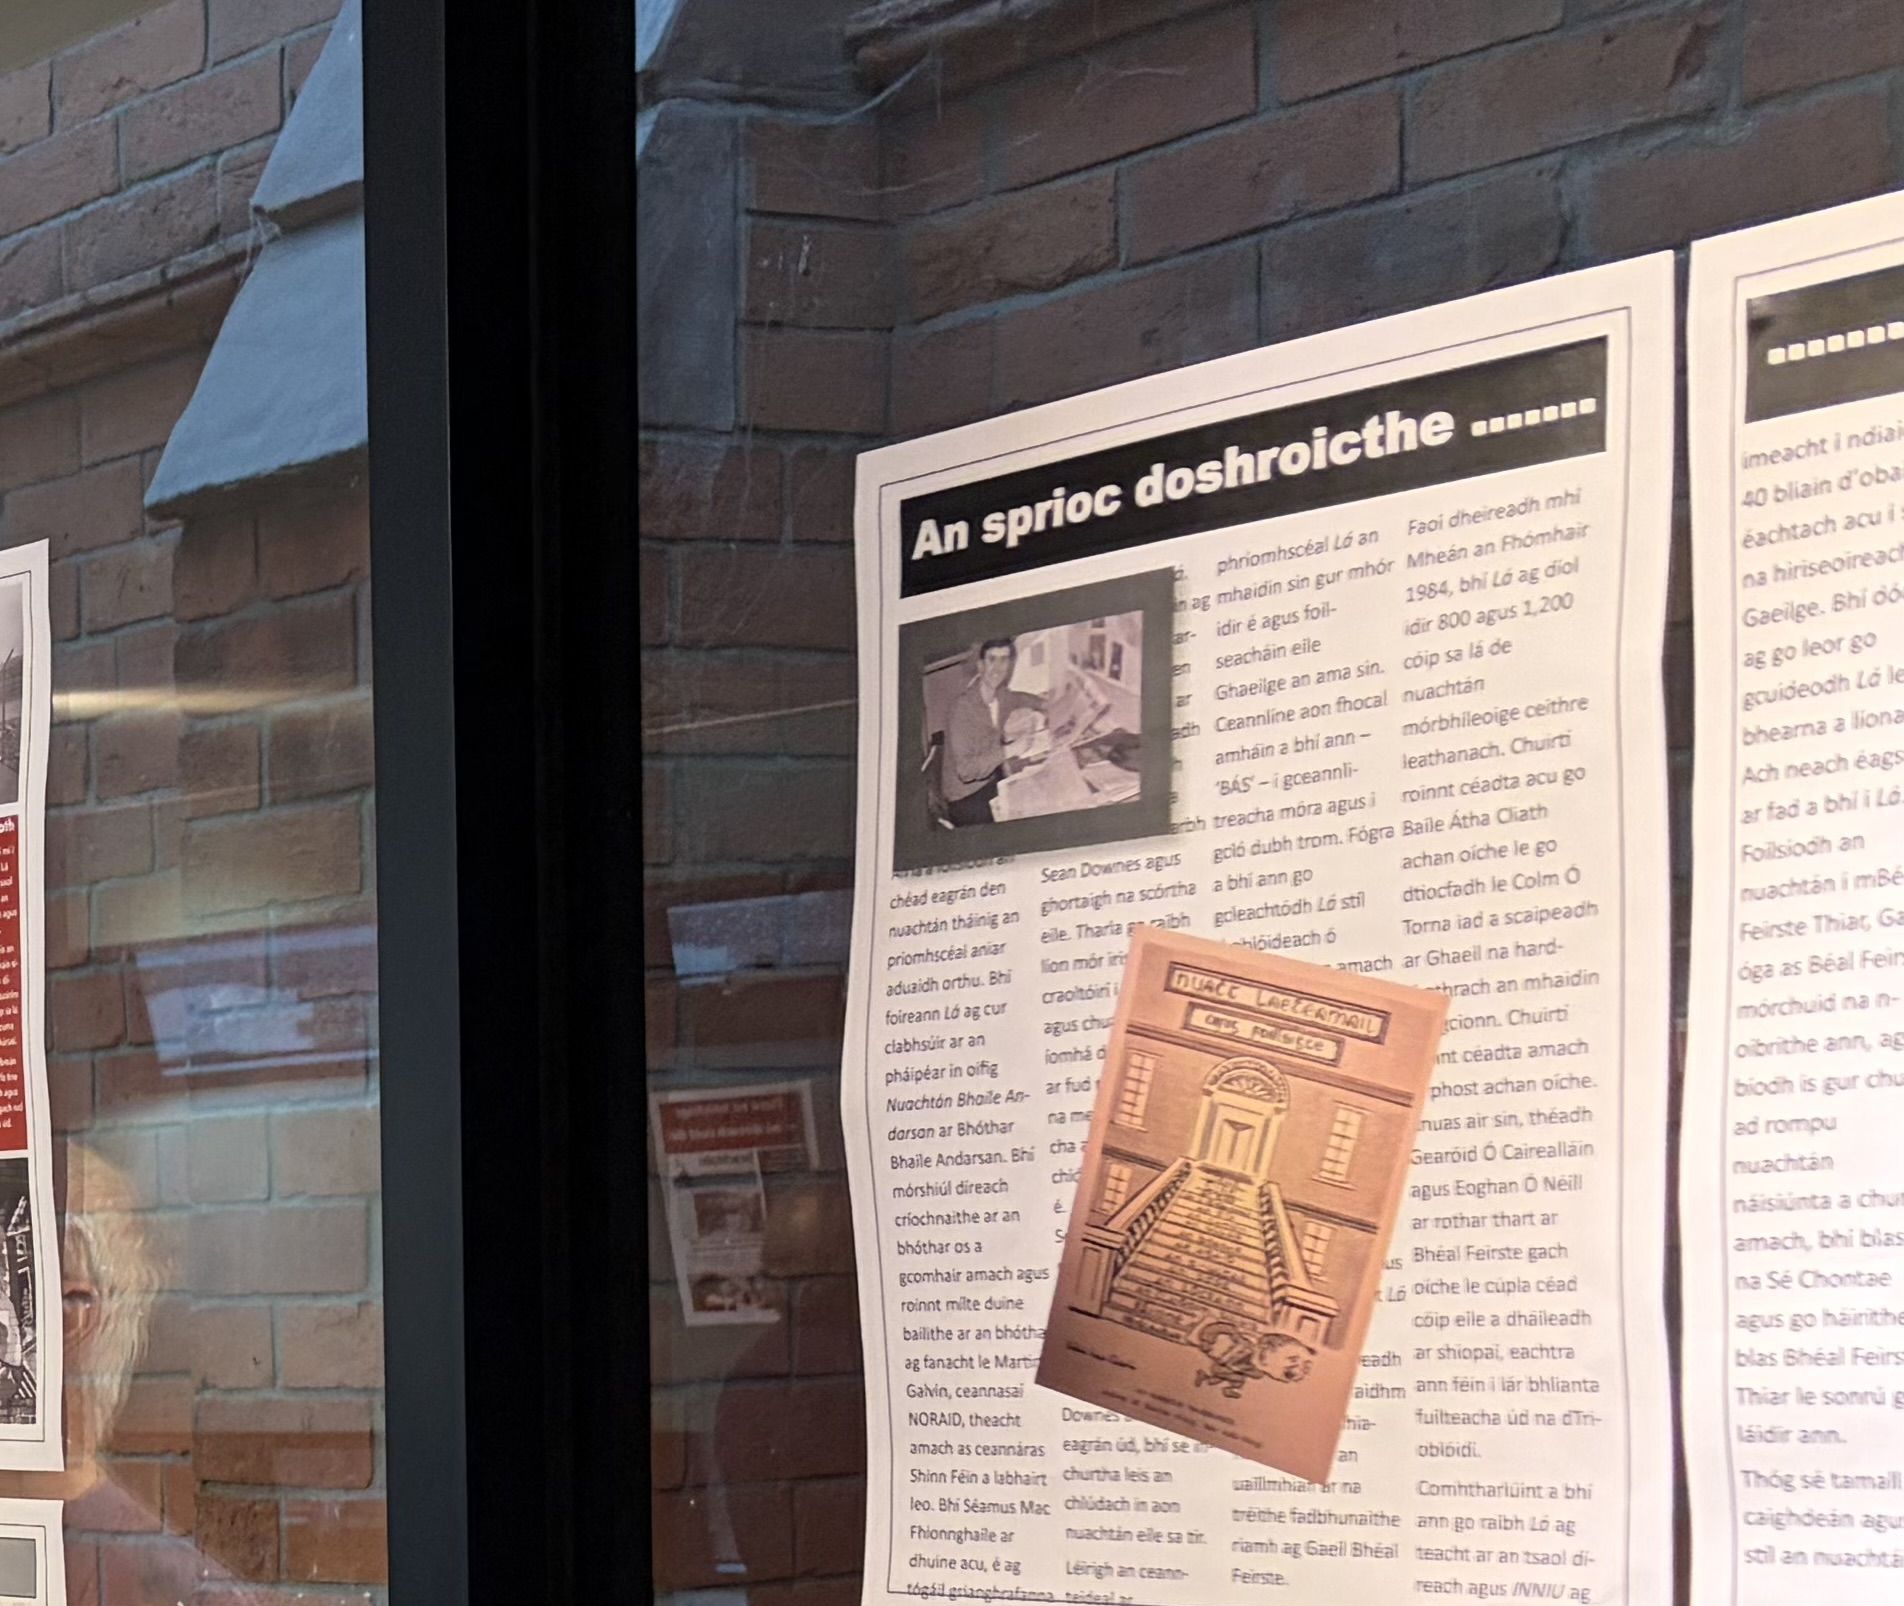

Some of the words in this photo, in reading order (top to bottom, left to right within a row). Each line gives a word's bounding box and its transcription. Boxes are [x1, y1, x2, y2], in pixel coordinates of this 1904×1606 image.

[911, 518, 968, 560] An
[981, 483, 1122, 547] sprioc
[1134, 409, 1455, 507] doshroicthe
[1408, 514, 1442, 535] Faoi
[1449, 497, 1539, 527] dheireadh
[1474, 542, 1494, 556] an
[1407, 580, 1453, 602] 1984,
[1519, 567, 1539, 584] ag
[1405, 618, 1432, 635] idir
[1438, 610, 1470, 630] 800
[1476, 605, 1516, 626] agus
[1524, 592, 1573, 616] 1,200
[1446, 649, 1462, 662] sa
[1489, 638, 1511, 655] de
[1744, 650, 1765, 669] ag
[1772, 645, 1796, 666] go
[1803, 637, 1843, 655] leor
[1851, 632, 1876, 654] go
[1525, 697, 1587, 718] ceithre
[1404, 742, 1504, 768] leathanach.
[1403, 784, 1454, 802] roinnt
[1527, 772, 1557, 786] acu
[1564, 767, 1585, 785] go
[1403, 817, 1444, 836] Baile
[1450, 809, 1489, 829] Átha
[1497, 803, 1547, 824] Cliath
[1402, 851, 1453, 869] achan
[1515, 840, 1528, 855] le
[1536, 839, 1557, 857] go
[1839, 835, 1864, 851] an
[981, 882, 1005, 896] den
[1404, 878, 1484, 902] dtiocfadh
[1492, 876, 1506, 891] le
[1513, 871, 1558, 890] Colm
[1566, 866, 1579, 884] Ó
[1003, 911, 1019, 923] an
[1402, 919, 1450, 934] Torna
[1458, 911, 1482, 929] iad
[1490, 913, 1498, 926] a
[1505, 901, 1598, 924] scaipeadh
[972, 943, 1005, 957] aniar
[1402, 955, 1420, 968] ar
[1427, 945, 1481, 965] Ghaeil
[1488, 946, 1508, 959] na
[1516, 938, 1563, 956] hard-
[887, 977, 938, 996] aduaidh
[943, 973, 983, 990] orthu.
[1484, 1141, 1496, 1160] Ó
[1736, 1275, 1761, 1289] na
[1799, 1269, 1891, 1288] Chontae
